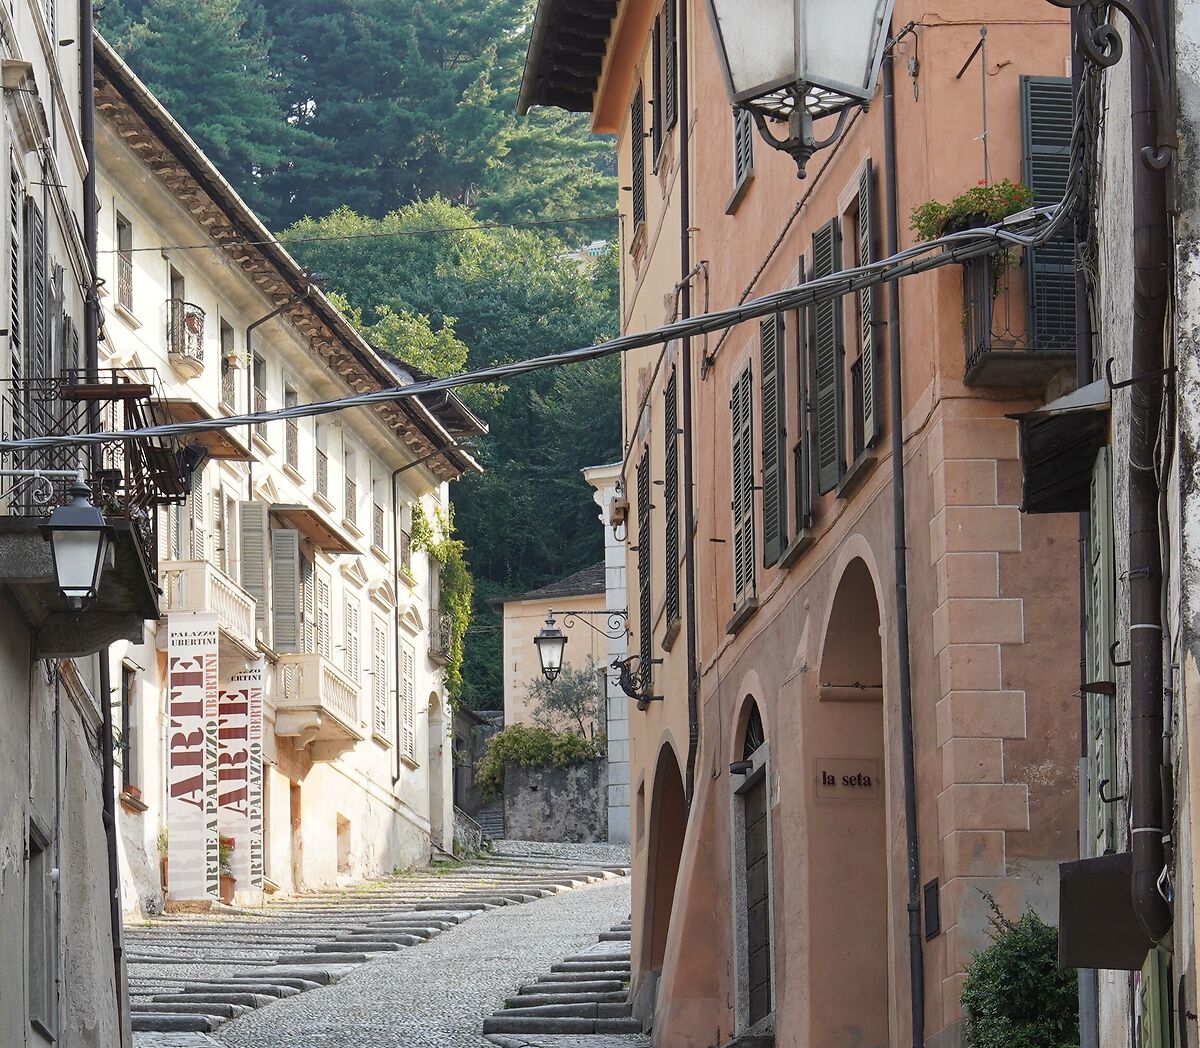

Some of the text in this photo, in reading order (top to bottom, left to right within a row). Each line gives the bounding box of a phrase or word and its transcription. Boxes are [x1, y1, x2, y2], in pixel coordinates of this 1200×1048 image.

[171, 638, 217, 646] UBERTINI
[170, 656, 204, 812] ARTE
[250, 687, 262, 740] UBERTINI
[205, 653, 219, 898] ARTE A PALAZZO UBERTINI
[218, 689, 249, 818] ARTE
[250, 742, 261, 820] PALAZZO
[822, 771, 871, 786] la seta
[250, 839, 262, 889] ARTE
